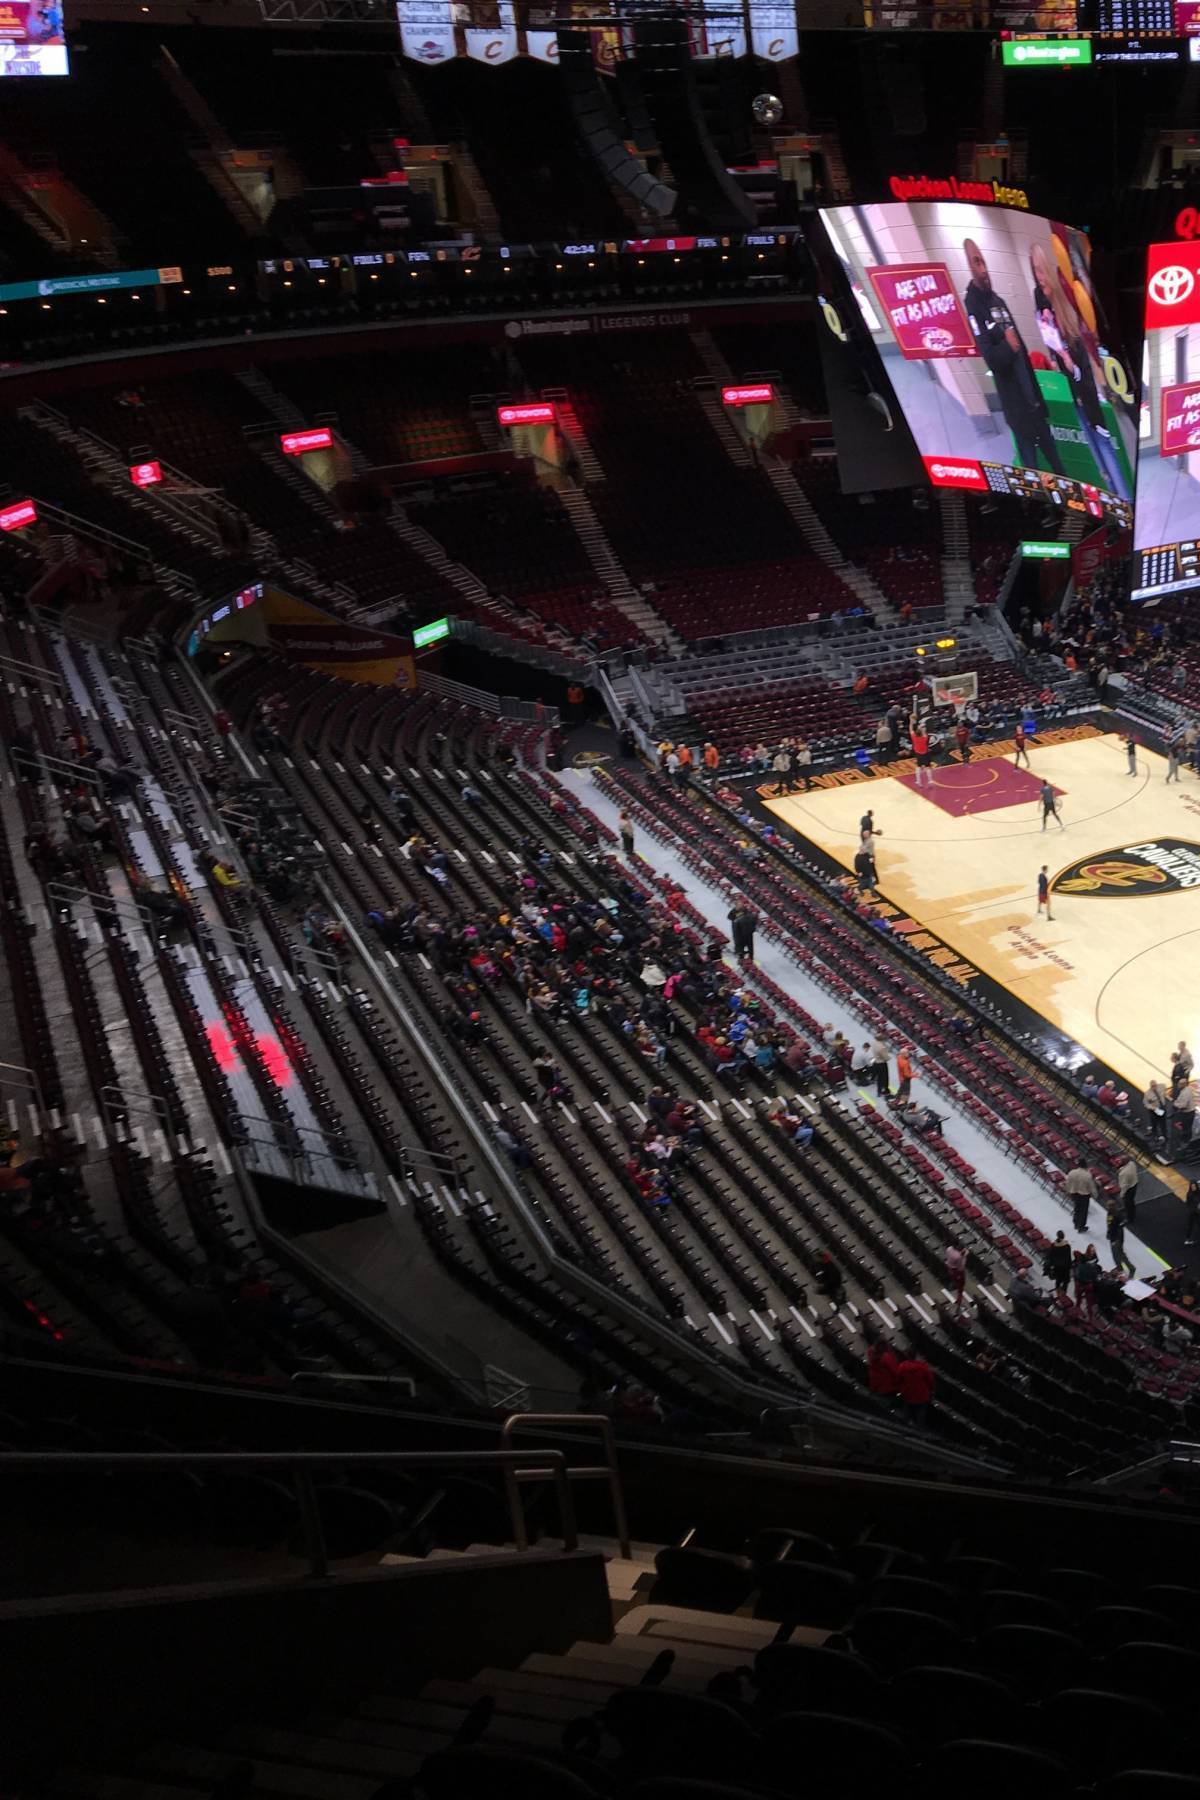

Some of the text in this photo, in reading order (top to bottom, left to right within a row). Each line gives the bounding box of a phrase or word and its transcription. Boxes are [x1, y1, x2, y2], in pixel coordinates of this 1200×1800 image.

[890, 175, 953, 202] Quicken
[992, 180, 1029, 208] Arena
[895, 275, 938, 300] ARE YOU
[522, 313, 690, 335] Huntington LEGENDS CLUB
[891, 307, 909, 327] FIT
[921, 300, 933, 318] A
[737, 389, 770, 398] TOYOTA
[516, 408, 552, 418] TOYOTA
[1166, 414, 1184, 432] FIT
[1185, 409, 1200, 425] AS
[944, 466, 980, 479] TOYOTA
[1008, 926, 1075, 970] Quicken Loans
[1008, 941, 1039, 960] Arena
